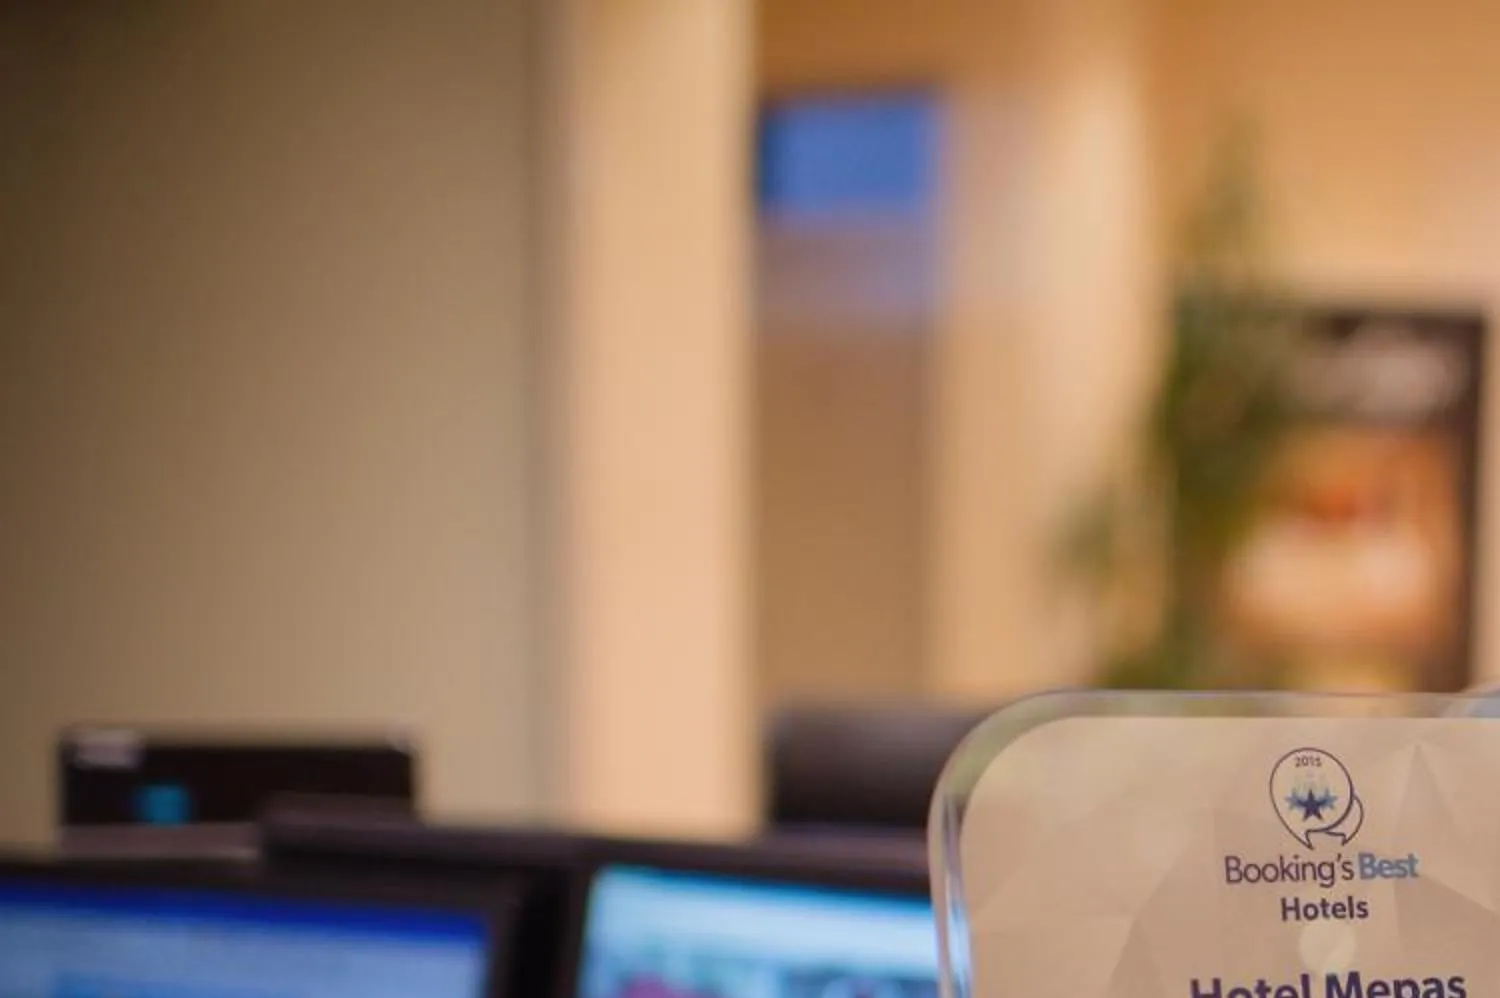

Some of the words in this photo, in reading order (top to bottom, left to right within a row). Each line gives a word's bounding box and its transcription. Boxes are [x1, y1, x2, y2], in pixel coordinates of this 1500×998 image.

[1294, 755, 1322, 768] 2015
[1224, 853, 1355, 888] Booking's
[1357, 851, 1420, 880] Best
[1280, 895, 1370, 922] Hotels
